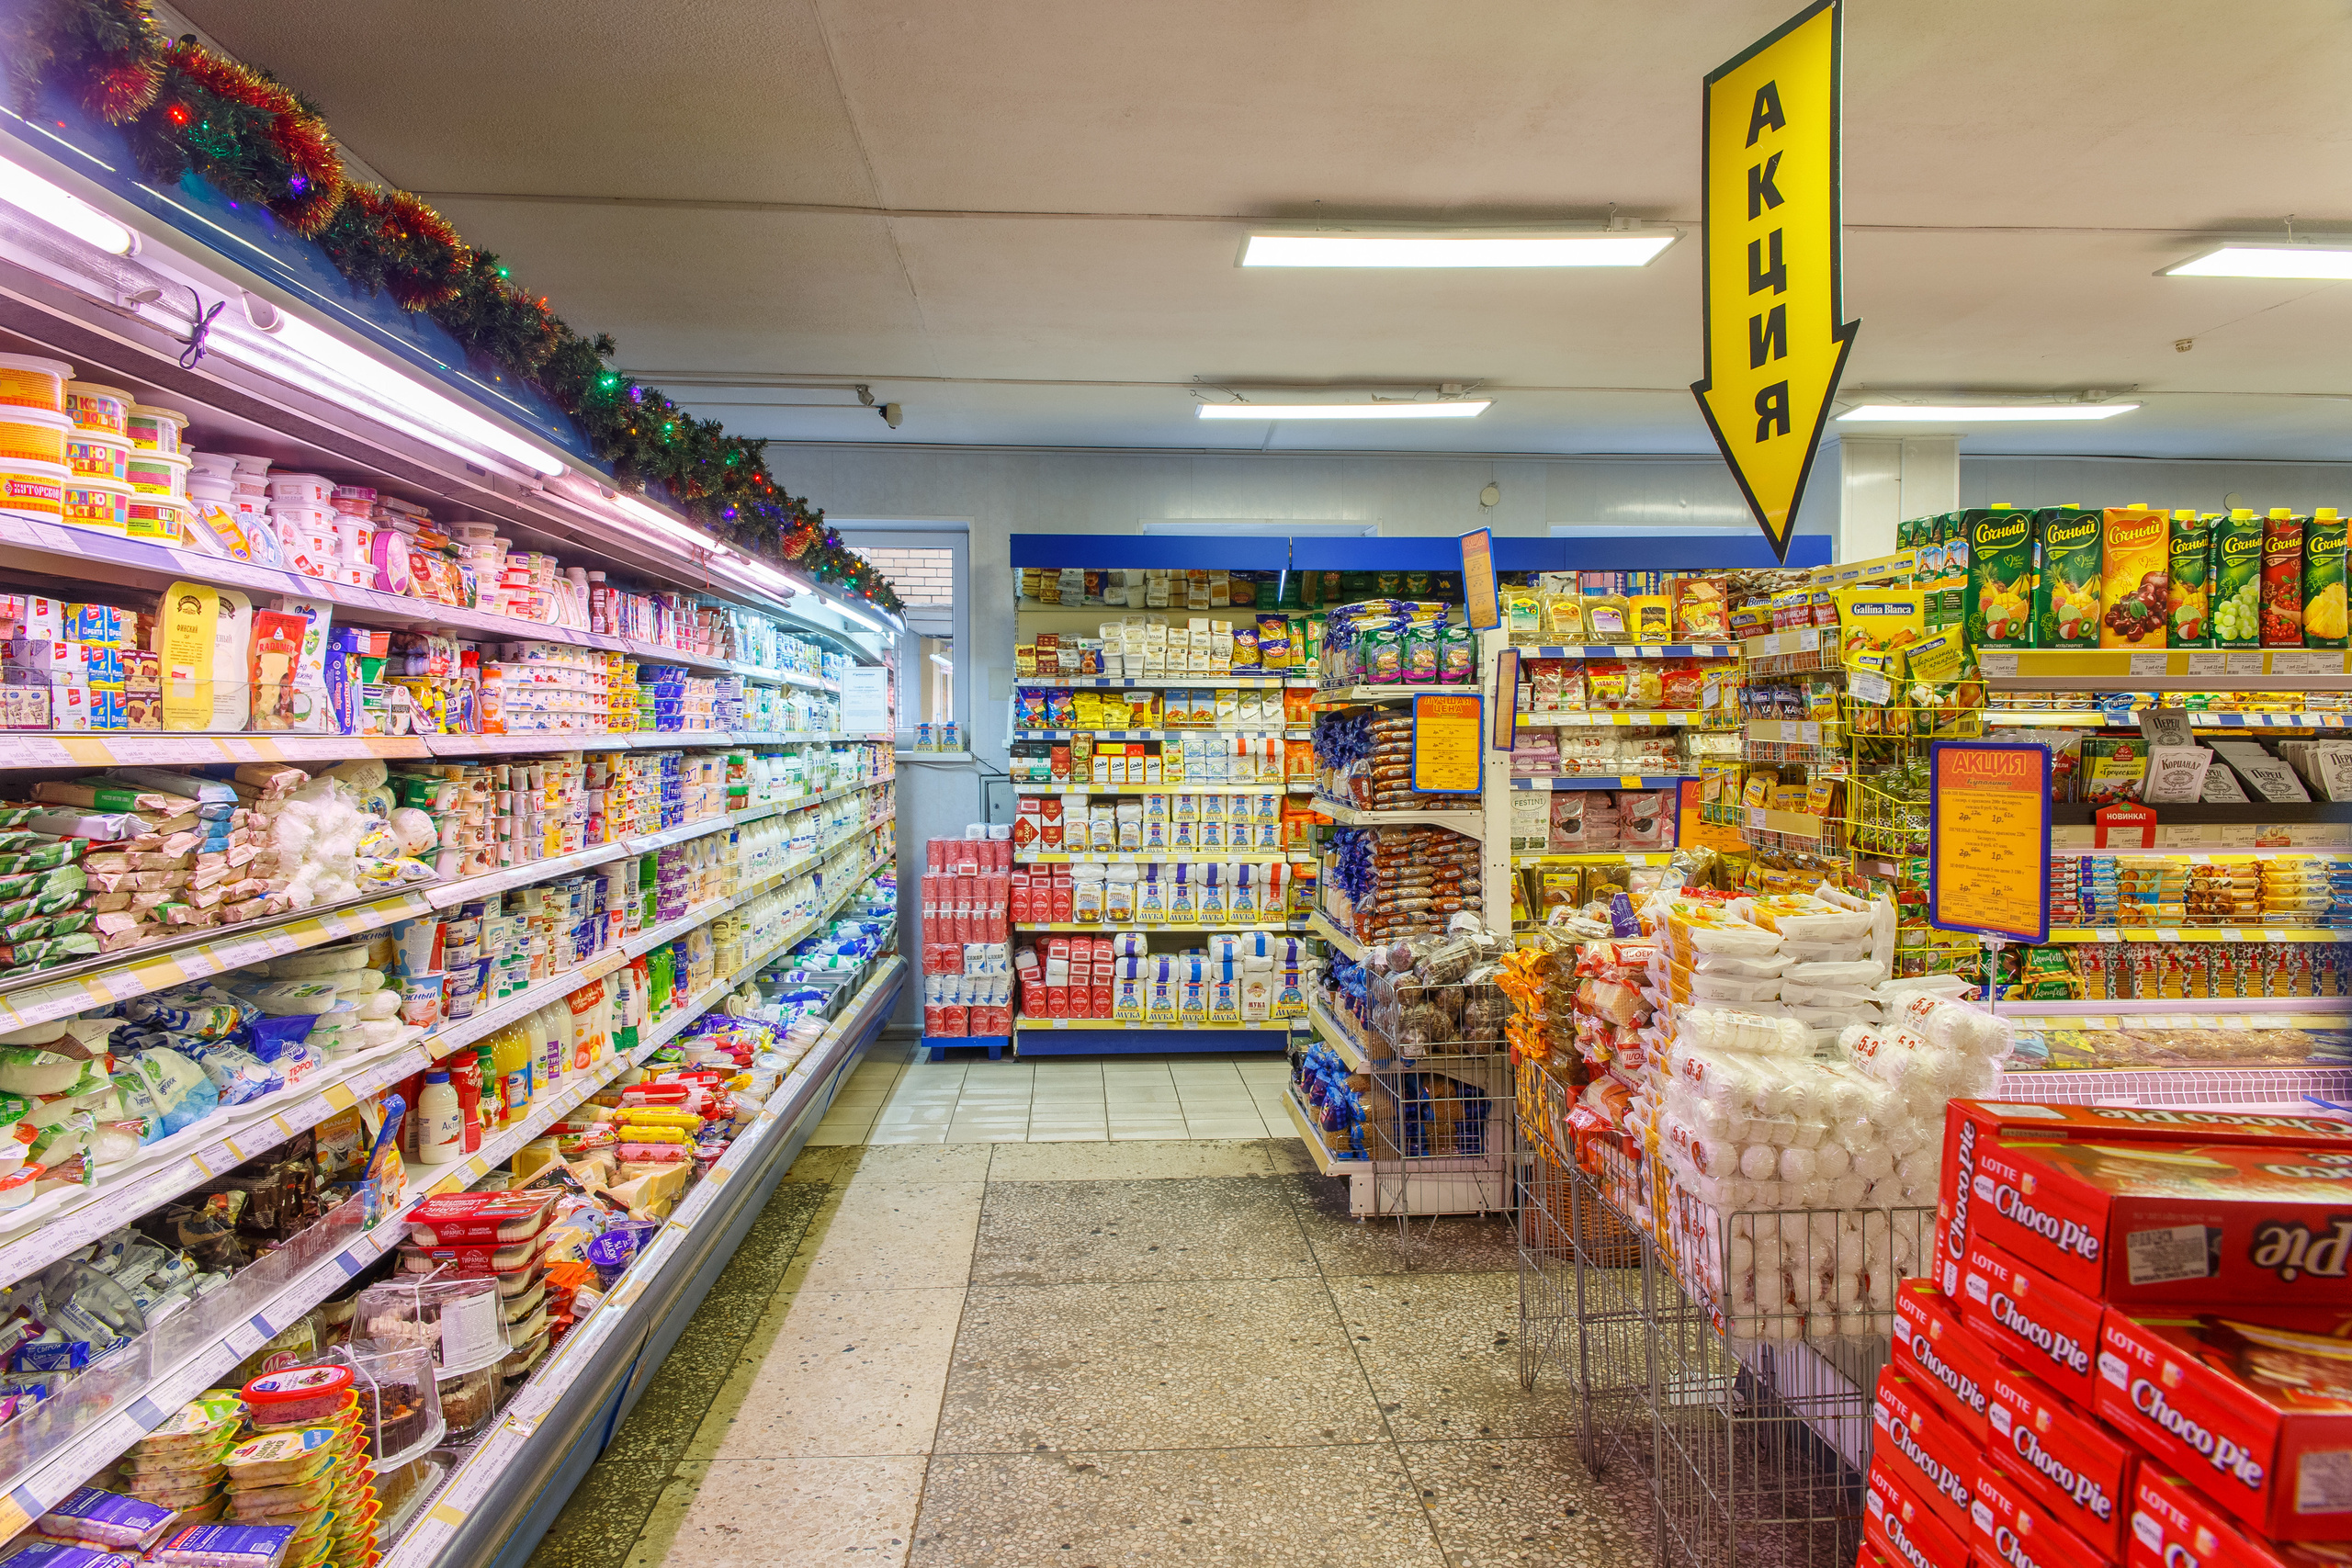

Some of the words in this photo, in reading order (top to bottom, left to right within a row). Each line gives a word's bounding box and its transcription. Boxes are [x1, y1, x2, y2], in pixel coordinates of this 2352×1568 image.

[1746, 80, 1791, 444] АКЦИЯ
[66, 444, 115, 460] ЛАДНОЕ
[65, 491, 114, 507] ЛАДНОЕ
[1975, 518, 2026, 544] Сочный
[2047, 518, 2097, 544] Сочный
[2109, 519, 2161, 545] Сочный
[1854, 604, 1883, 615] Gallina
[1884, 604, 1912, 615] Blanca
[176, 625, 198, 634] ФИНСКИЙ
[259, 642, 294, 654] RADAMER
[1906, 645, 1925, 657] Gallina
[1926, 638, 1946, 649] Blanca
[1424, 696, 1472, 705] ЛУЧШАЯ
[1433, 705, 1463, 714] ЦЕНА
[2153, 718, 2180, 729] ПЕРЕЦ
[1952, 751, 2026, 777] АКЦИЯ
[2162, 759, 2201, 770] КОРИАНДР
[2330, 753, 2352, 766] ПЕР
[684, 767, 697, 782] 27
[2251, 769, 2285, 780] ПЕРЕЦ
[695, 795, 704, 813] 21
[1514, 797, 1544, 807] FESTINI
[1992, 815, 2004, 824] 1р.
[1991, 852, 2004, 861] 1р.
[1991, 887, 2004, 897] 1р.
[2032, 953, 2064, 964] Konafetto
[1981, 993, 2003, 1001] ROEN
[2035, 987, 2067, 998] Konafetto
[1912, 998, 1927, 1011] 5
[1920, 1001, 1935, 1016] 3
[1858, 1035, 1870, 1052] 5
[1867, 1040, 1879, 1057] 3
[323, 1116, 352, 1130] DANAO
[1959, 1120, 1976, 1176] Pie
[1981, 1156, 2017, 1181] LOTTE
[1949, 1170, 1971, 1260] Choco
[1994, 1183, 2061, 1240] Choco
[2057, 1218, 2099, 1260] Pie
[1935, 1229, 1944, 1282] LOTTE
[1972, 1251, 2008, 1282] LOTTE
[1898, 1295, 1928, 1325] LOTTE
[1990, 1292, 2052, 1349] Choco
[2050, 1331, 2089, 1373] Pie
[2106, 1326, 2156, 1367] LOTTE
[1912, 1334, 1959, 1390] Choco
[1956, 1374, 1986, 1414] Pie
[1879, 1385, 1909, 1417] LOTTE
[1994, 1380, 2031, 1415] LOTTE
[2131, 1378, 2215, 1455] Choco
[2210, 1434, 2264, 1489] Pie
[1889, 1416, 1939, 1481] Choco
[1937, 1464, 1969, 1509] Pie
[2012, 1425, 2075, 1492] Choco
[2072, 1472, 2112, 1520] Pie
[1871, 1470, 1900, 1505] LOTTE
[1977, 1477, 2013, 1516] LOTTE
[2140, 1483, 2190, 1533] LOTTE
[1996, 1526, 2041, 1568] Cho
